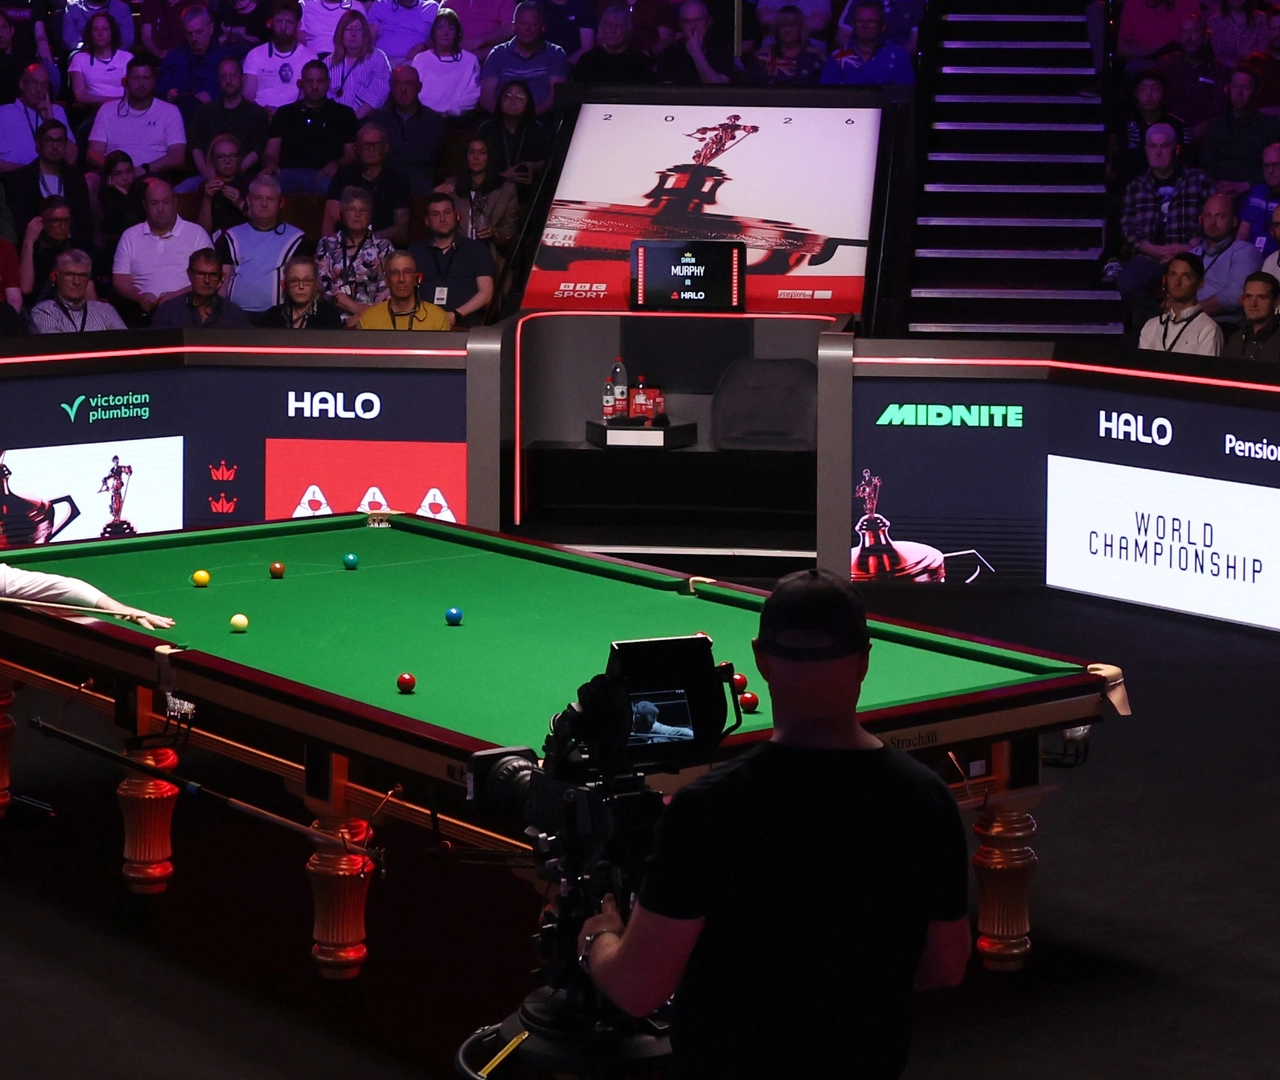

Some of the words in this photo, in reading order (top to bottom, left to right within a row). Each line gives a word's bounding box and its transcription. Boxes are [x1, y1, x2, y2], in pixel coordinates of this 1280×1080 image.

[671, 266, 705, 277] MURPHY
[559, 283, 607, 291] BBC
[680, 292, 705, 300] HALO
[89, 391, 150, 407] victorian
[288, 391, 381, 419] HALO
[89, 405, 150, 423] plumbing
[876, 403, 1023, 427] MIDNITE
[1099, 410, 1173, 446] HALO
[1134, 510, 1215, 547] WORLD
[1088, 530, 1264, 585] CHAMPIONSHIP
[890, 731, 938, 749] Strachan
